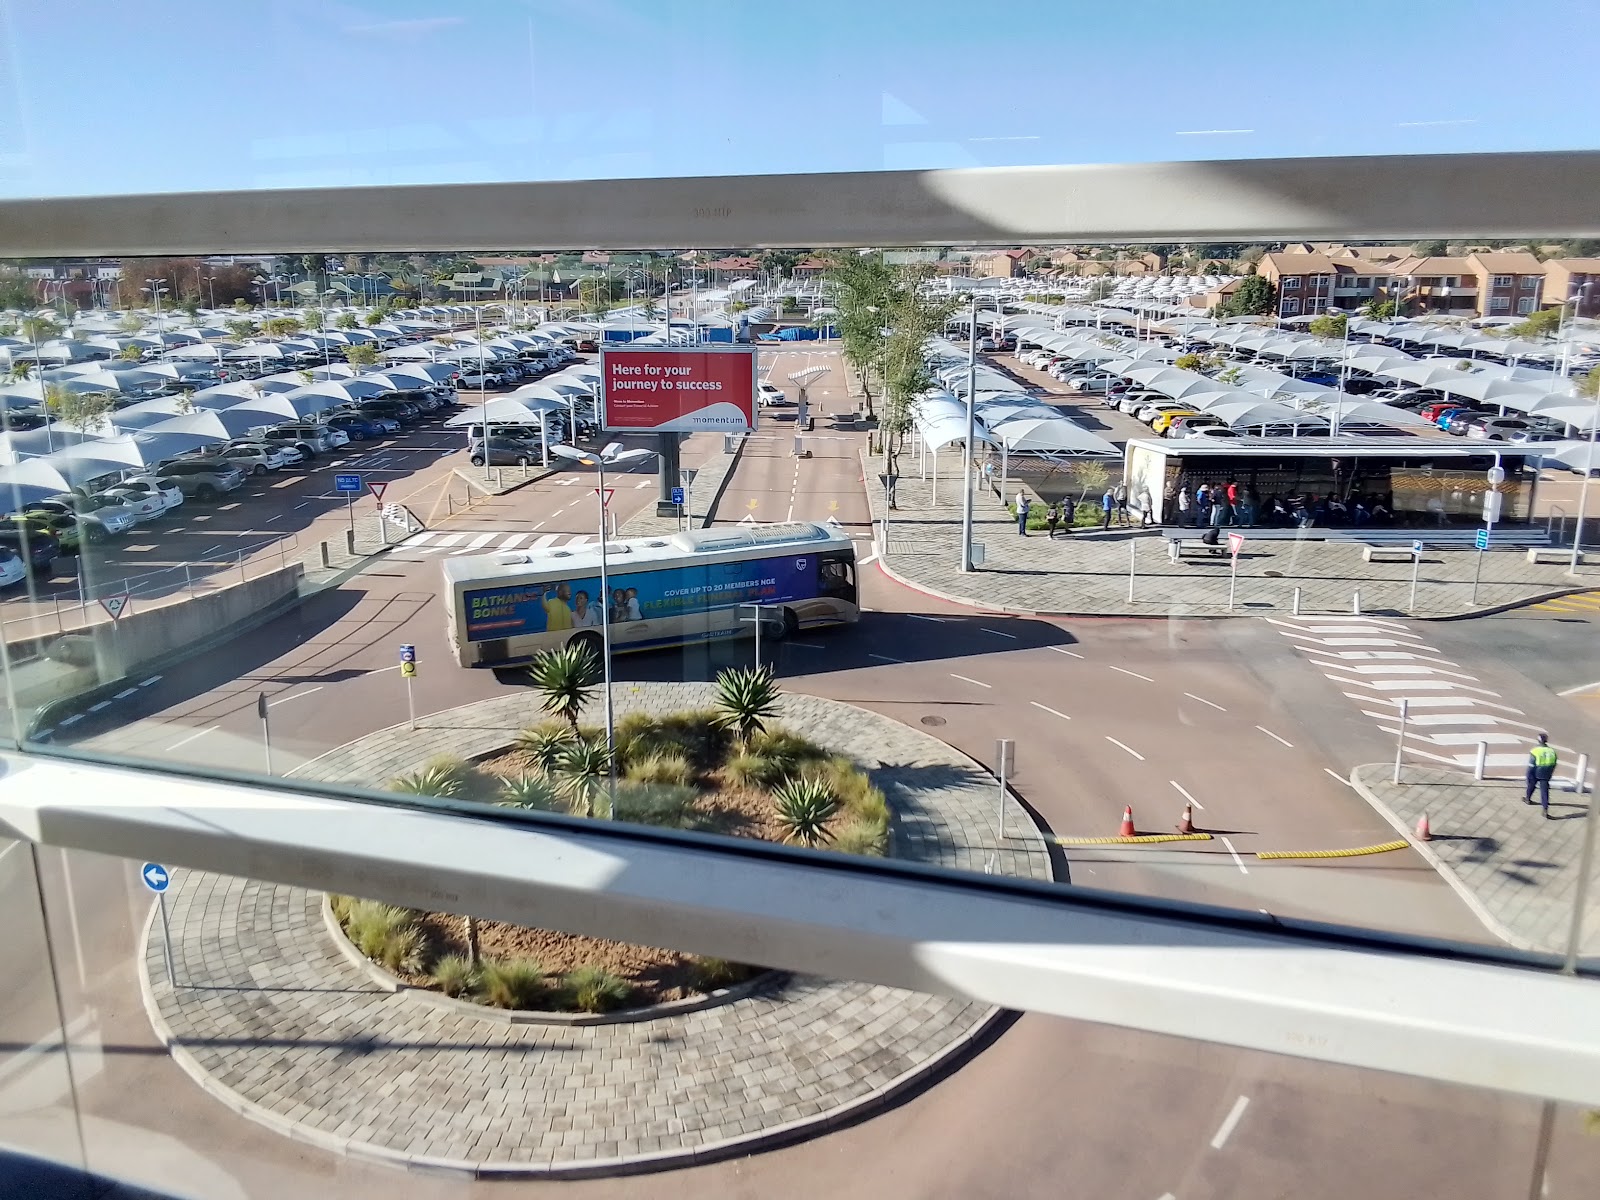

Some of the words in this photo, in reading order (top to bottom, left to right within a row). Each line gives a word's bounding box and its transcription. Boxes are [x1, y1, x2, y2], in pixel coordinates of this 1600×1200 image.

[612, 363, 641, 375] Here
[643, 363, 662, 375] for
[664, 366, 691, 377] your
[612, 378, 658, 392] journey
[660, 379, 674, 390] to
[675, 380, 722, 391] success
[692, 416, 743, 424] momentum
[664, 588, 689, 597] COVER
[690, 586, 701, 594] UP
[702, 585, 713, 593] TO
[724, 580, 760, 590] MEMBERS
[760, 578, 776, 586] NGE
[473, 605, 516, 619] BONKE
